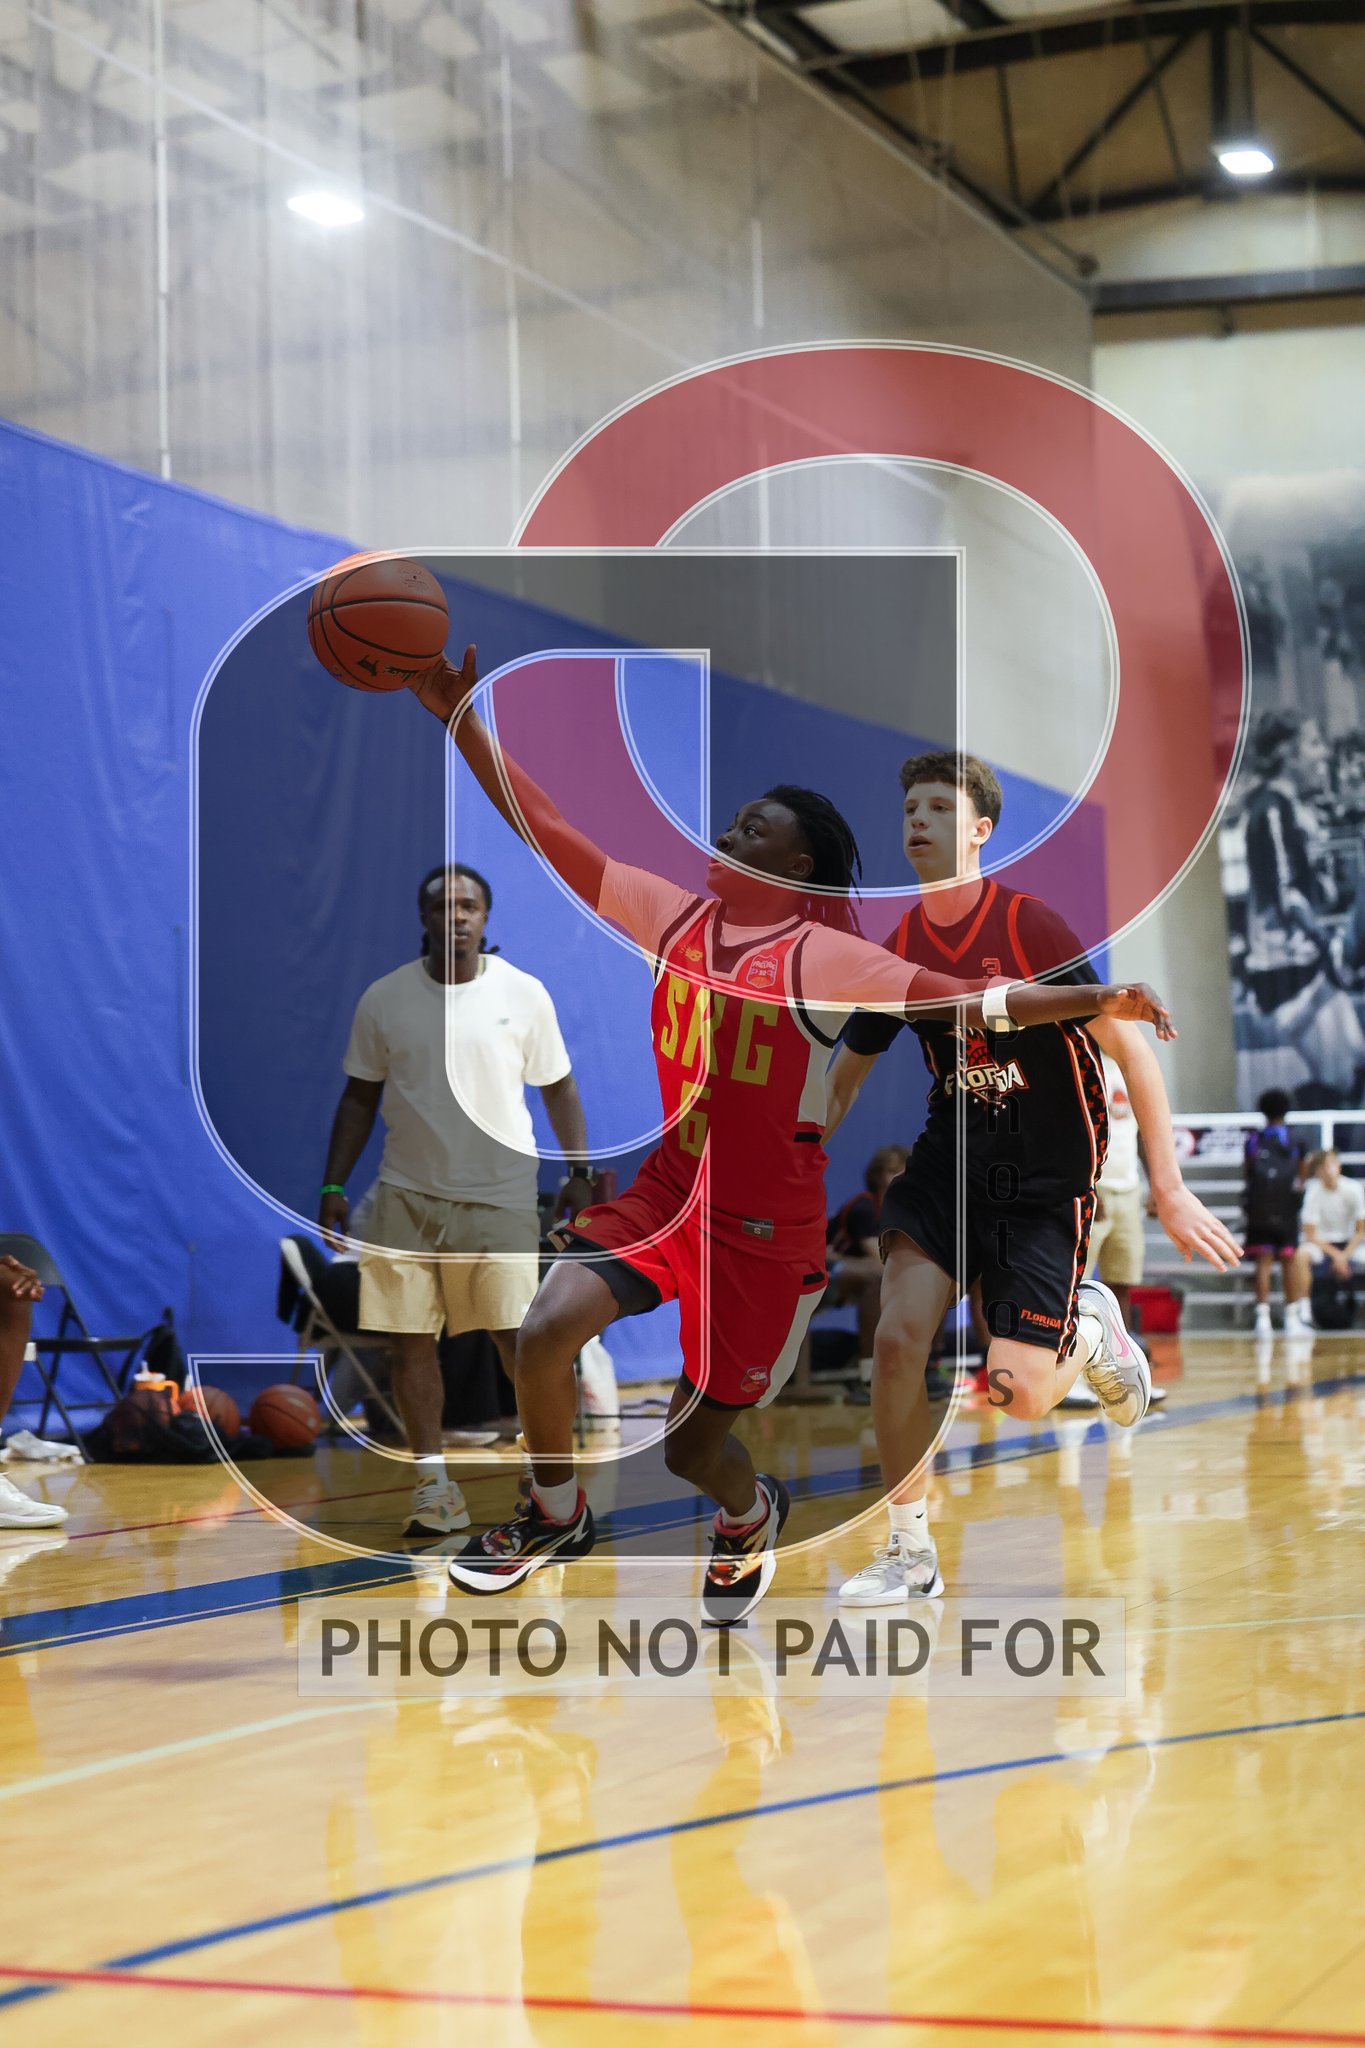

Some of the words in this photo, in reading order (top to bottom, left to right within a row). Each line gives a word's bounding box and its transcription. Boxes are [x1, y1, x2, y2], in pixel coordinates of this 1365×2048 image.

[944, 1061, 1025, 1096] FLORDA
[678, 1080, 711, 1157] 6
[1020, 1308, 1062, 1330] FLORIDA
